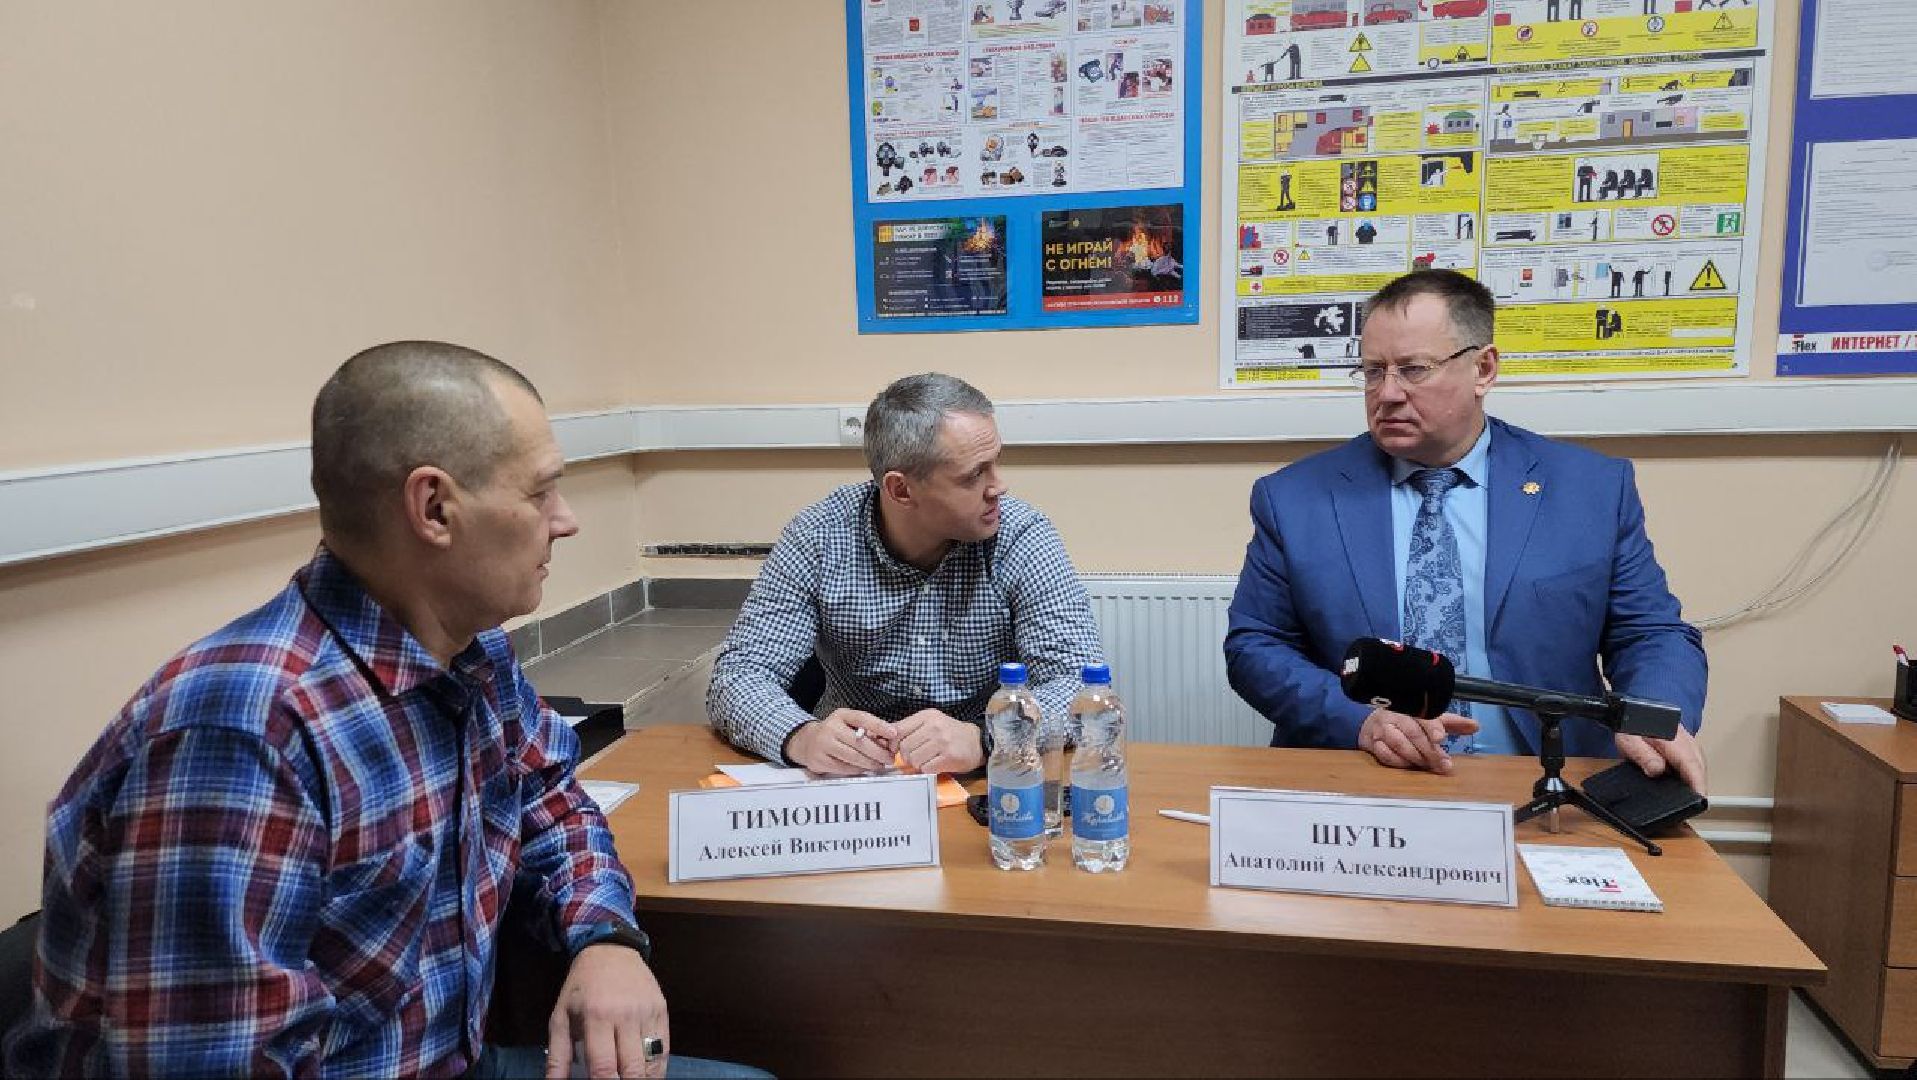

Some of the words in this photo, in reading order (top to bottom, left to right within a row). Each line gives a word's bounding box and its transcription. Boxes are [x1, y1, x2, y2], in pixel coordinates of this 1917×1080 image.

[1046, 243, 1064, 255] НЕ
[1067, 237, 1113, 253] ИГРАЙ
[1046, 260, 1056, 271] С
[1831, 335, 1901, 350] ИНТЕРНЕТ
[727, 802, 883, 830] ТИМОШИН
[700, 839, 782, 860] Алексей
[790, 834, 911, 855] Викторович
[1312, 823, 1407, 849] ШУТЬ
[1224, 852, 1325, 873] Анатолий
[1333, 858, 1502, 885] Александрович
